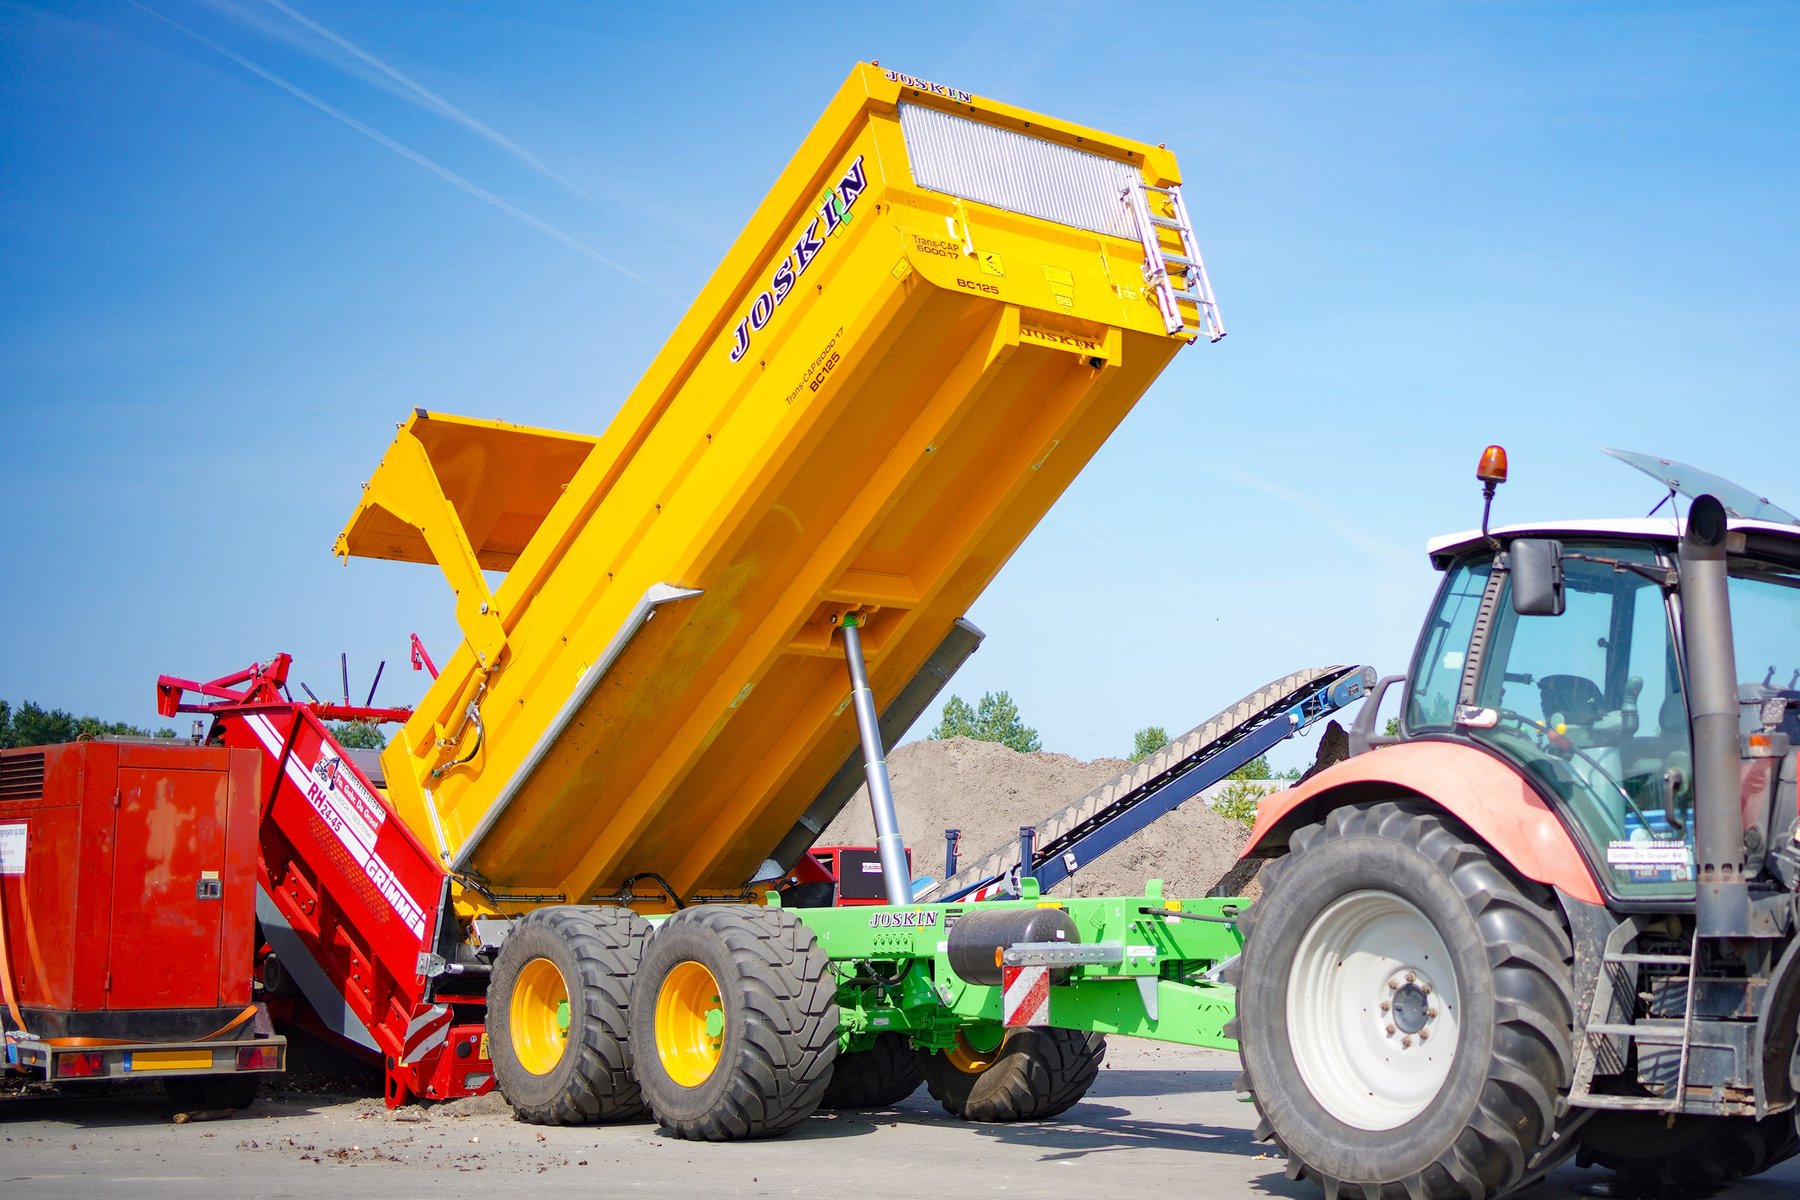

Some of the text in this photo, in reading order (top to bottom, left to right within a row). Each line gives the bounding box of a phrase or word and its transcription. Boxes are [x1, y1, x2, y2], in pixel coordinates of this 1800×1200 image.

[885, 69, 972, 104] JOSKIN
[911, 234, 959, 251] Trans-CAP
[917, 245, 959, 260] 6000 17
[729, 155, 868, 363] JOSKIN
[956, 278, 999, 295] BC125
[1020, 327, 1096, 350] JOSKIN
[809, 352, 840, 393] BC125
[307, 781, 342, 832] RH 24-45
[869, 910, 938, 928] JOSKIN
